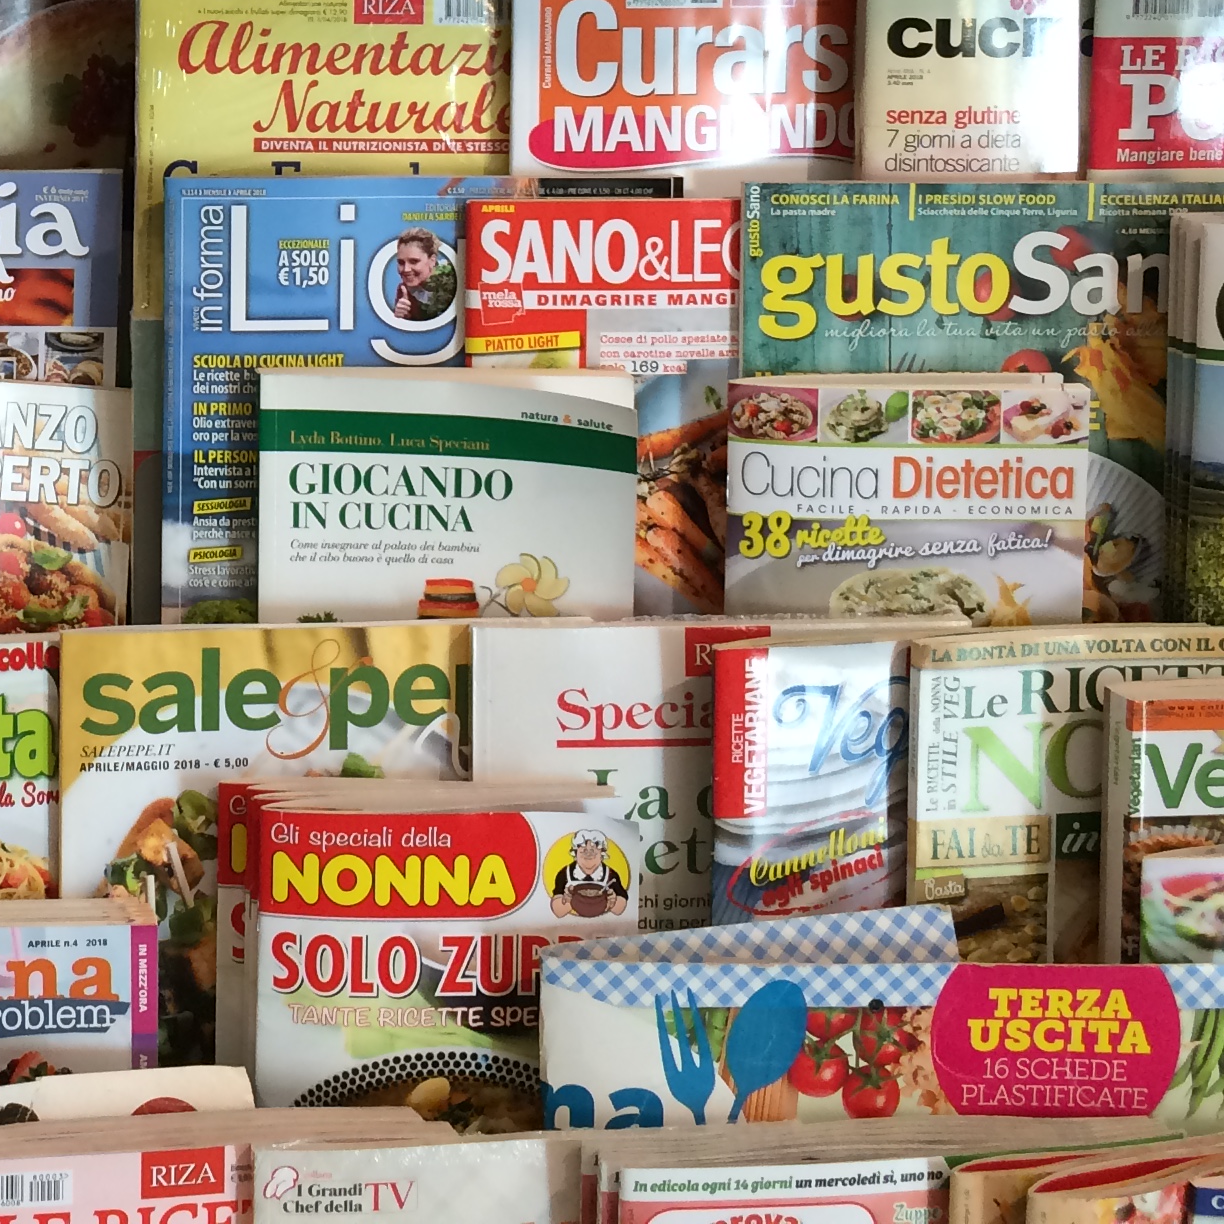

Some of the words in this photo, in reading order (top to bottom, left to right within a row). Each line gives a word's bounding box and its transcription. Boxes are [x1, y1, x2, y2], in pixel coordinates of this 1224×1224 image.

[261, 138, 316, 152] DIVENTA
[318, 139, 329, 152] IL
[332, 139, 429, 153] NUTRIZIONISTA
[886, 130, 898, 149] 7
[903, 128, 956, 154] giorni
[960, 134, 972, 149] a
[976, 128, 1022, 150] dieta
[771, 194, 831, 205] CONOSCI
[834, 194, 850, 205] LA
[853, 194, 899, 205] FARINA
[484, 336, 522, 352] PIATTO
[525, 334, 560, 349] LIGHT
[289, 462, 513, 501] GIOCANDO
[741, 452, 879, 500] Cucina
[892, 455, 1074, 500] Dietetica
[289, 502, 327, 530] IN
[339, 502, 473, 532] CUCINA
[739, 511, 792, 558] 38
[796, 515, 886, 549] ricette
[822, 540, 915, 570] dimagrire
[920, 536, 982, 558] senza
[988, 528, 1052, 556] fatica!
[79, 761, 170, 774] APRILE/MAGGIO
[174, 759, 201, 771] 2018
[214, 757, 221, 769] €
[224, 756, 249, 771] 5,00
[270, 822, 300, 846] Gli
[308, 828, 393, 848] speciali
[401, 826, 452, 848] della
[270, 850, 516, 907] NONNA
[989, 988, 1131, 1020] TERZA
[967, 1019, 1151, 1054] USCITA
[984, 1059, 1009, 1079] 16
[1016, 1058, 1128, 1083] SCHEDE
[961, 1084, 1149, 1110] PLASTIFICATE
[150, 1163, 217, 1187] RIZA
[633, 1180, 647, 1193] In
[651, 1180, 699, 1192] edicola
[702, 1178, 731, 1194] ogni
[734, 1180, 748, 1191] 14
[751, 1176, 792, 1193] giorni
[796, 1179, 813, 1189] un
[815, 1172, 881, 1187] mercoledì
[900, 1171, 925, 1183] uno
[927, 1170, 943, 1181] no
[306, 1183, 363, 1198] Grandi
[365, 1181, 414, 1211] TV
[283, 1200, 318, 1215] Chef
[321, 1199, 363, 1214] della
